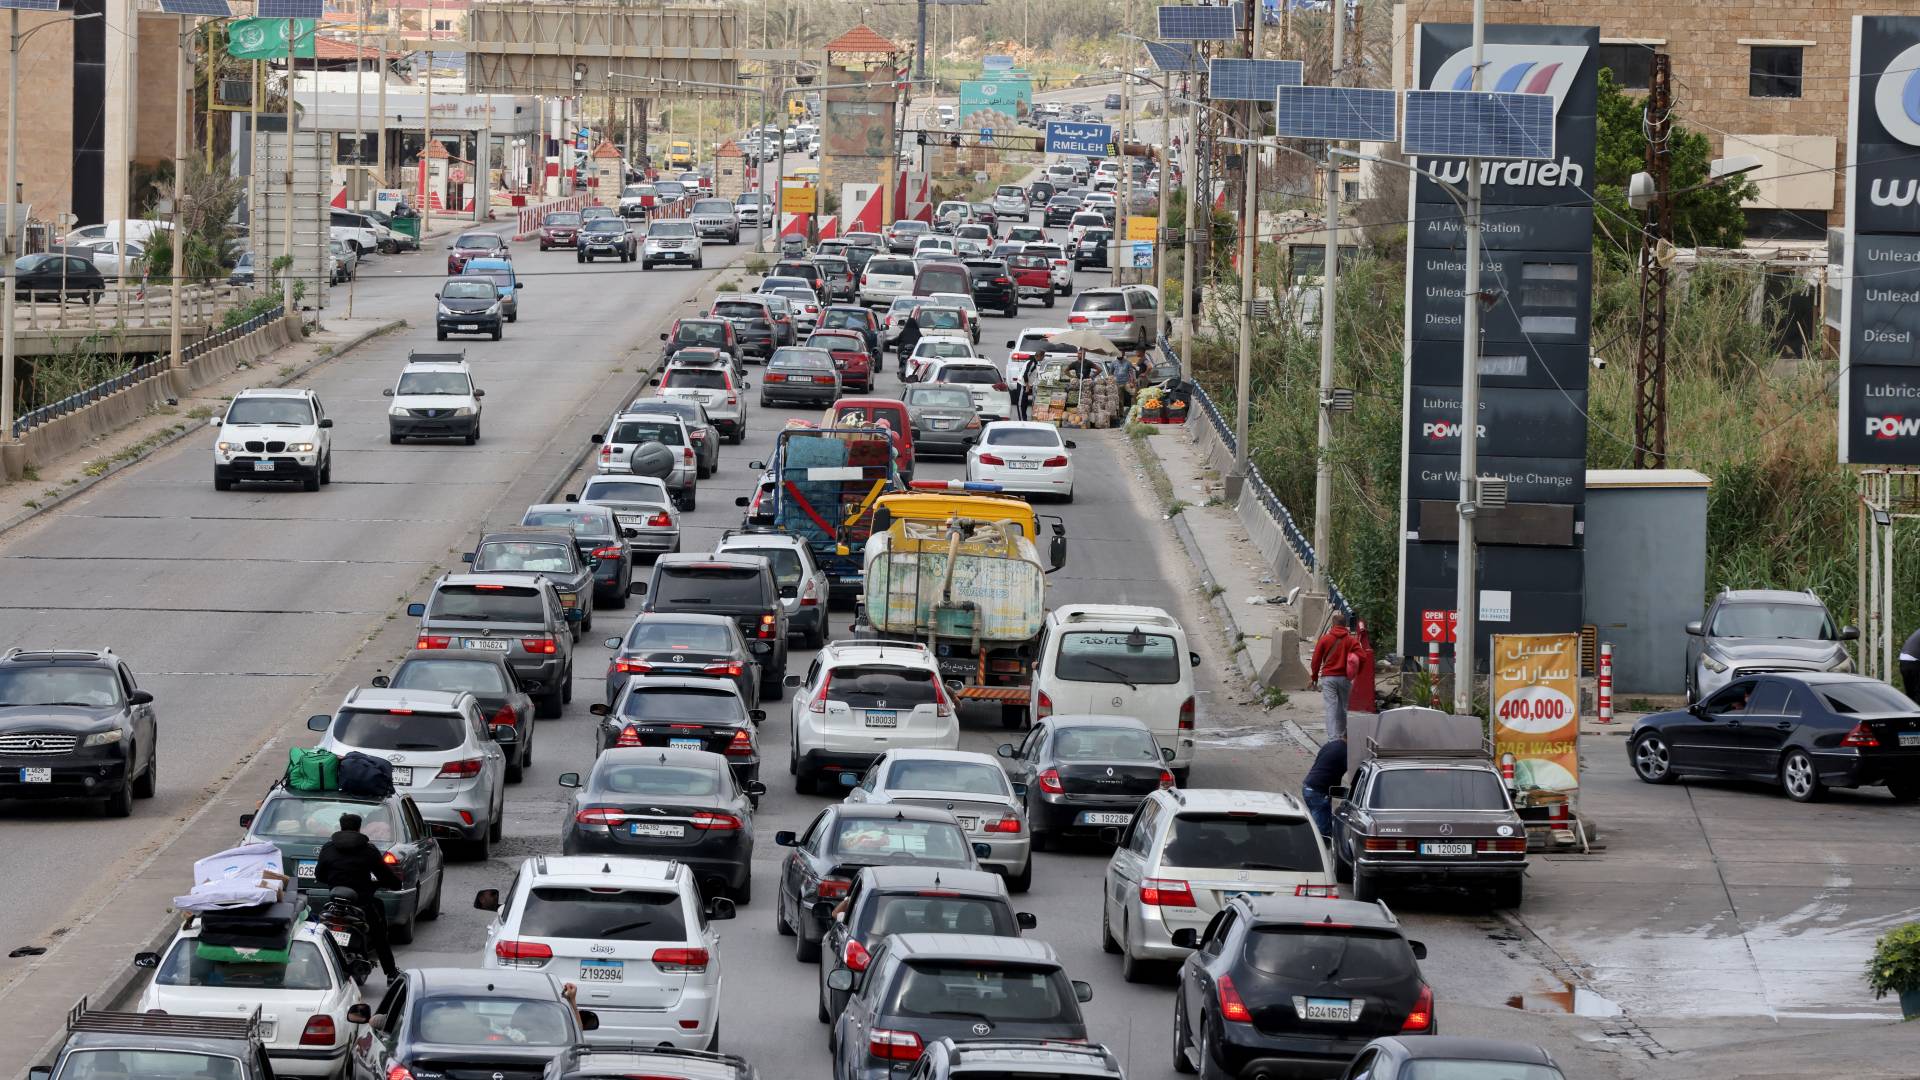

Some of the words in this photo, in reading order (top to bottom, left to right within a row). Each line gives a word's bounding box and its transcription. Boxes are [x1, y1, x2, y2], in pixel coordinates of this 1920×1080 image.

[1053, 124, 1103, 140] الرميلة
[1053, 140, 1103, 152] RMEILEH
[1870, 178, 1920, 207] w
[1480, 222, 1521, 233] Station
[1487, 262, 1503, 272] 98
[1866, 289, 1920, 303] Unlead
[1425, 314, 1462, 325] Diesel
[1864, 329, 1910, 343] Diesel
[1423, 398, 1486, 410] Lubricas
[1423, 423, 1486, 438] POWR
[1421, 470, 1443, 481] Car
[1526, 473, 1573, 487] Change
[1424, 611, 1444, 620] OPEN
[1507, 638, 1565, 660] غسيل
[1502, 665, 1570, 685] سيارات
[1499, 699, 1564, 721] 400,000
[1496, 741, 1526, 756] CAR
[1530, 740, 1575, 755] WASH
[1102, 814, 1129, 824] 192286
[1426, 845, 1432, 854] N
[1437, 844, 1467, 854] 120050
[590, 944, 616, 955] Jeep
[581, 968, 622, 980] Z192994
[1308, 1006, 1349, 1019] G241676
